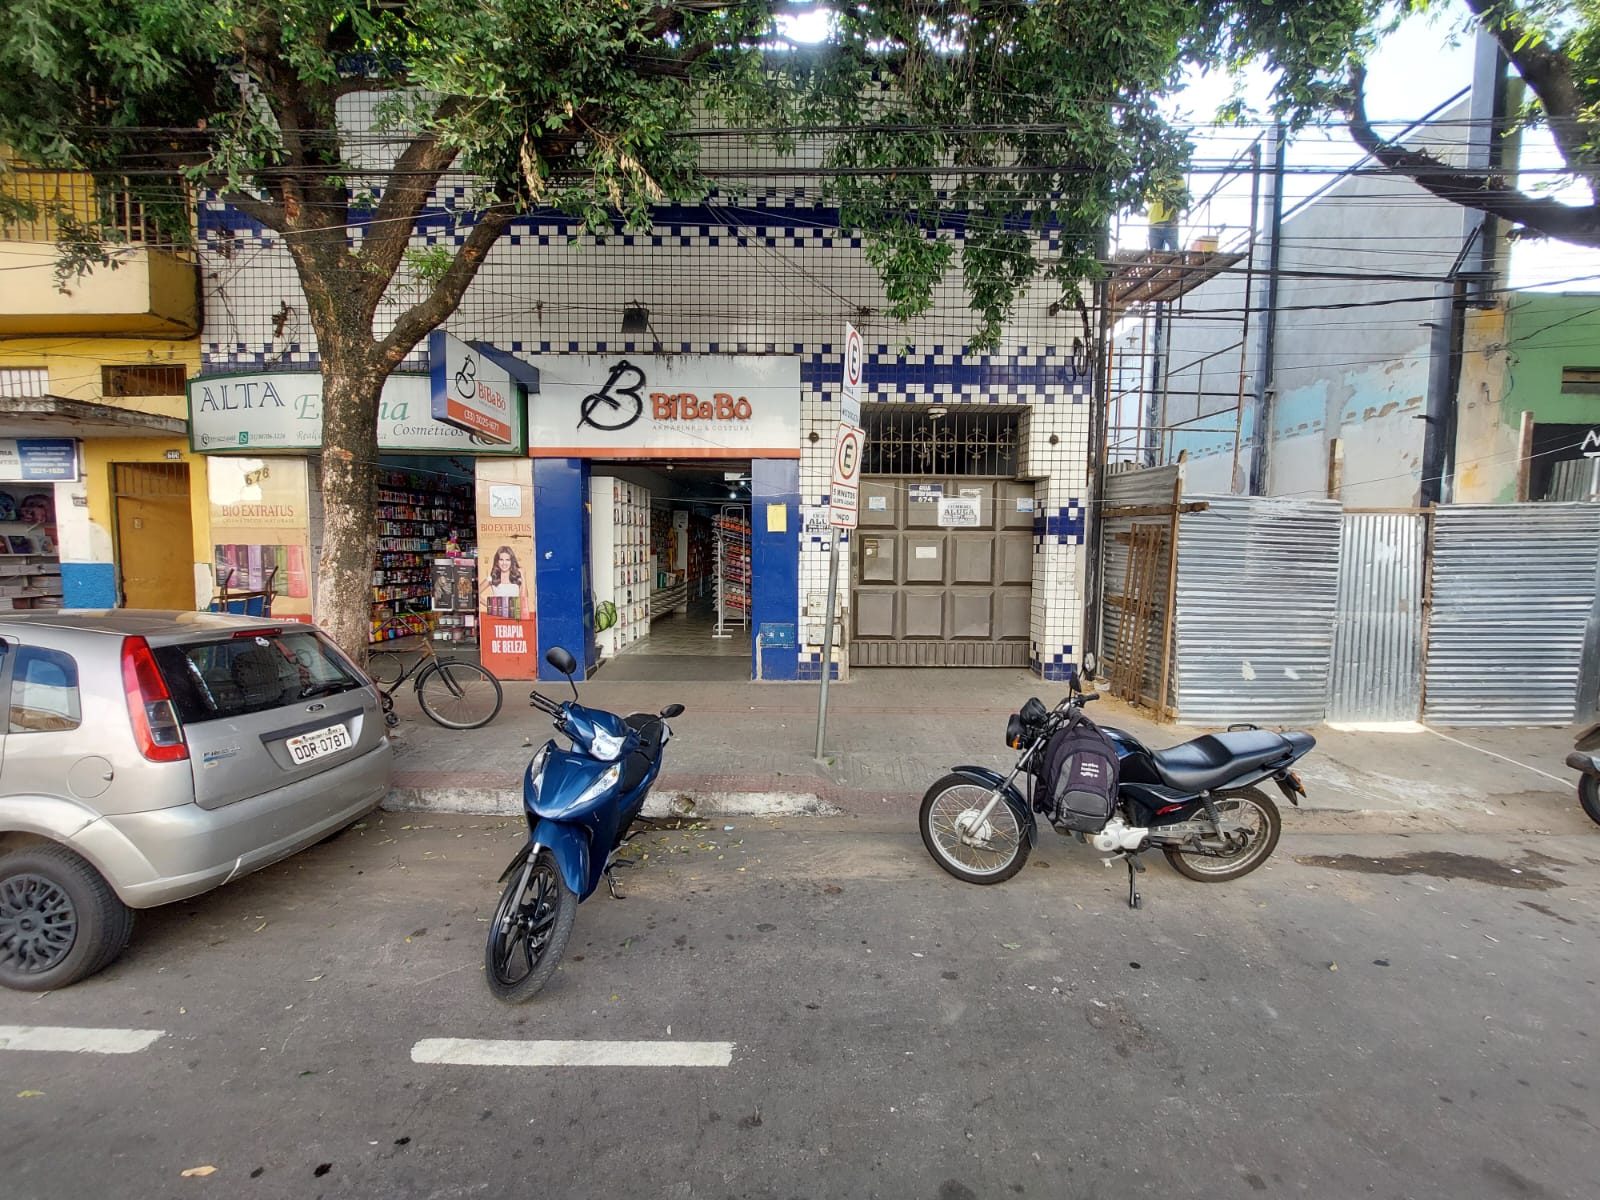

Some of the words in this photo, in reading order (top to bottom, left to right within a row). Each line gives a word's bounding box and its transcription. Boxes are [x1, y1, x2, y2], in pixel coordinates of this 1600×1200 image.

[200, 381, 286, 412] ALTA
[650, 393, 752, 420] BiBaBô
[393, 423, 464, 437] Cosméticos
[222, 505, 240, 517] BIO
[241, 504, 294, 517] EXTRATUS
[480, 523, 494, 532] BIO
[494, 523, 532, 532] EXTRATUS
[494, 624, 524, 639] TERAPIA
[491, 640, 502, 654] DE
[502, 640, 528, 654] BELEZA
